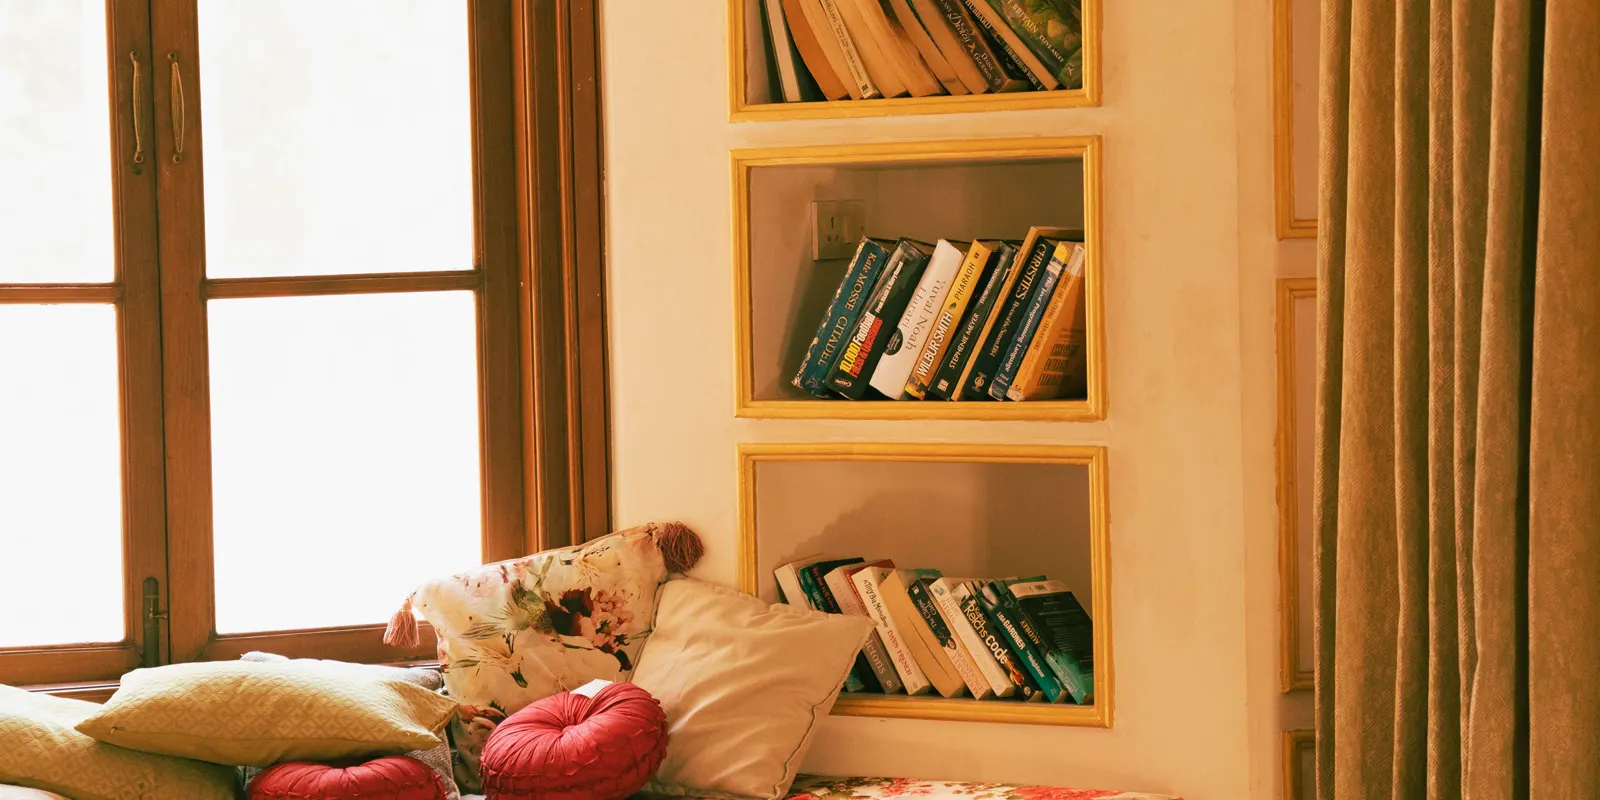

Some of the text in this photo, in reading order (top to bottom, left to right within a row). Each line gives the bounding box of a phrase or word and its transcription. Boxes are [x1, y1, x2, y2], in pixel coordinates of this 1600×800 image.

[963, 0, 992, 29] HUBBARD
[1010, 2, 1040, 33] BRITAIN
[1037, 34, 1053, 49] CLIVE
[843, 251, 877, 311] Kate MOSSE
[952, 261, 977, 300] PHARAOH
[1036, 286, 1047, 302] Java
[1043, 275, 1053, 288] The
[901, 285, 927, 329] Harari
[904, 277, 946, 352] Yuval Noah
[1016, 301, 1041, 344] Programming
[816, 314, 849, 368] CITADEL
[837, 341, 863, 375] 10,000
[851, 310, 876, 346] Football
[860, 316, 885, 353] Questions
[915, 310, 955, 377] WILBUR SMITH
[947, 311, 981, 369] STEPHENIE MEYER
[848, 356, 865, 378] Facts
[857, 349, 868, 360] &
[1002, 342, 1021, 372] Language
[885, 629, 914, 677] DAWN FRENCH
[962, 603, 992, 638] Reichs
[983, 632, 1012, 666] code
[1001, 618, 1027, 650] GARDNER
